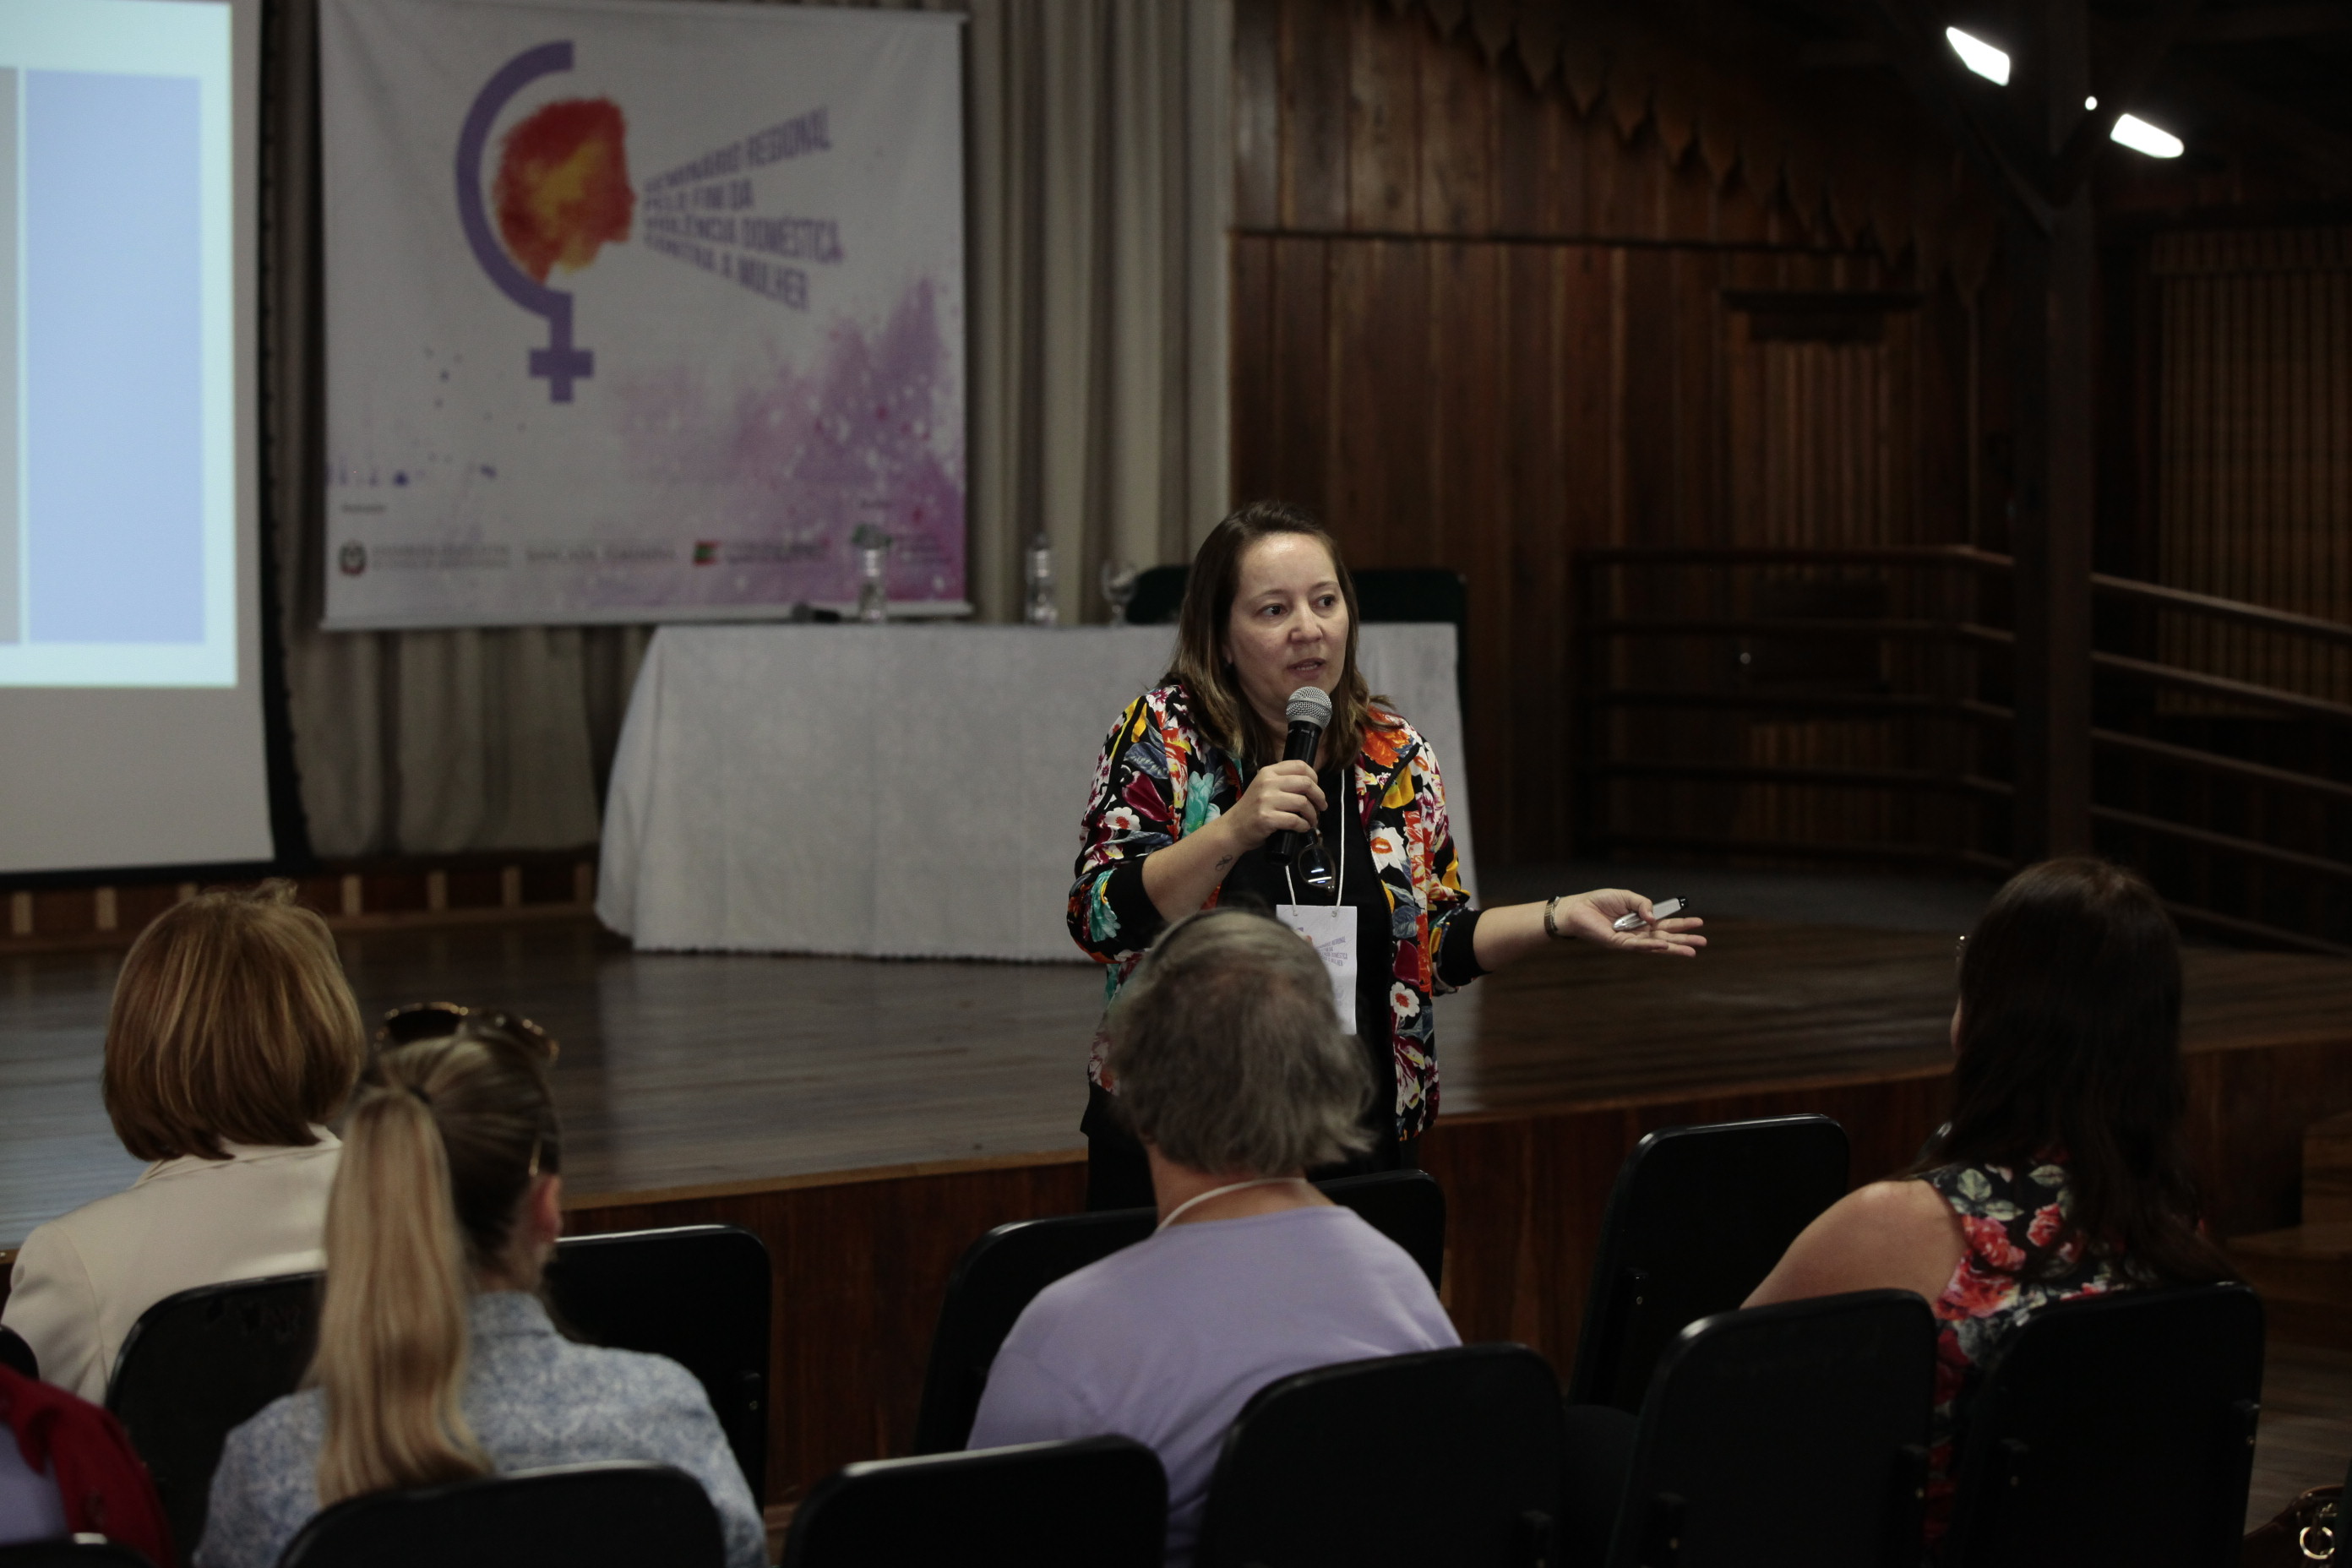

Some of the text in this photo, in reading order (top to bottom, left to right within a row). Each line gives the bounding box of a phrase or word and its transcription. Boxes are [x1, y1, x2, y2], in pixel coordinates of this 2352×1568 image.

[747, 106, 831, 166] REGIONAL
[729, 178, 754, 210] DA
[742, 215, 843, 265] DOMÉSTICA
[738, 256, 809, 310] MULHER
